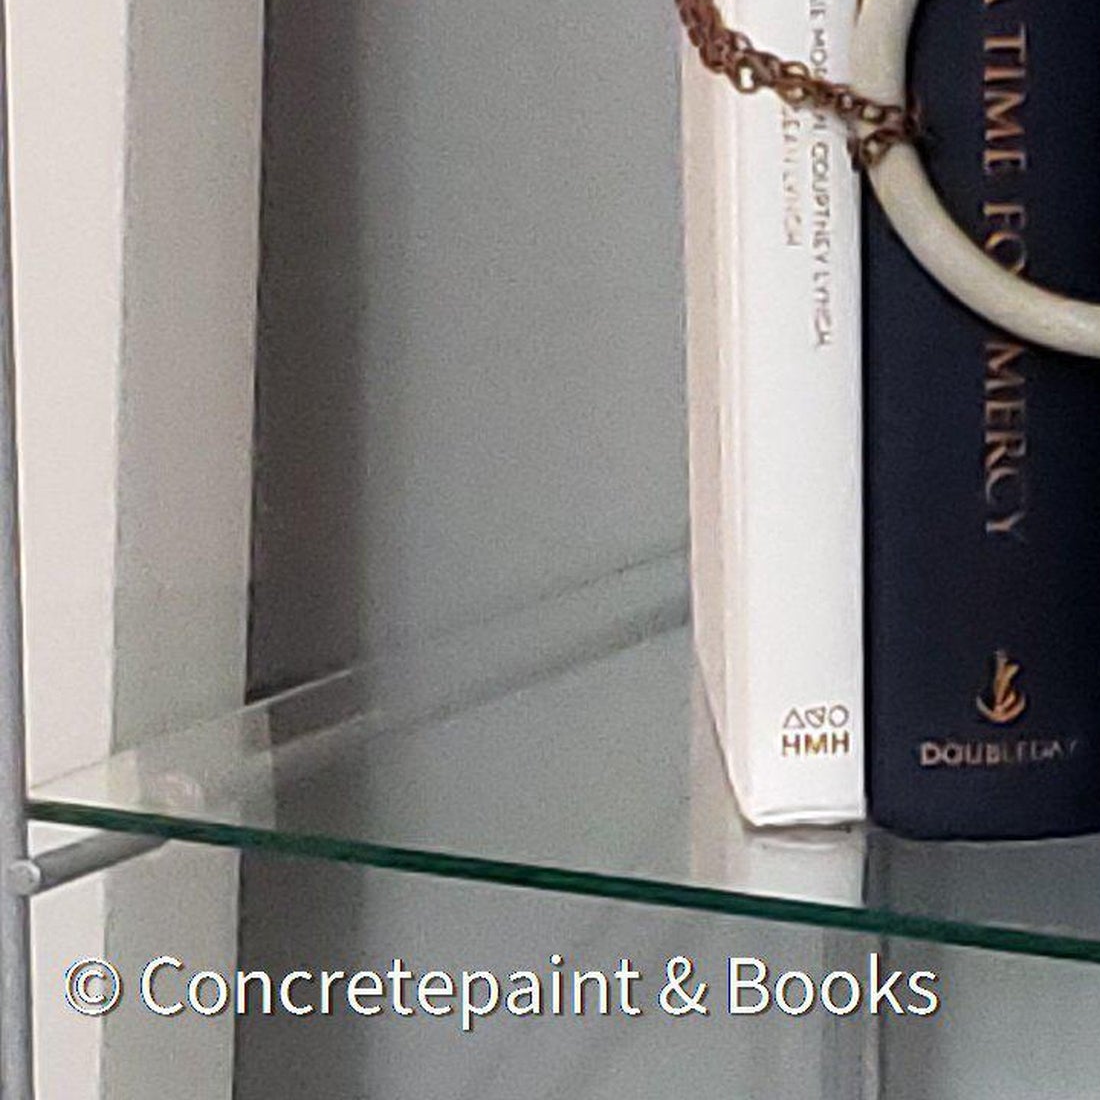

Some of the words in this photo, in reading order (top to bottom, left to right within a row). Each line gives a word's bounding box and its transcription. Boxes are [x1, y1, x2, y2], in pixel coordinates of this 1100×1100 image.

[983, 24, 1028, 174] TIME
[983, 200, 1027, 279] FO
[984, 341, 1028, 543] MERCY
[782, 730, 850, 756] HMH
